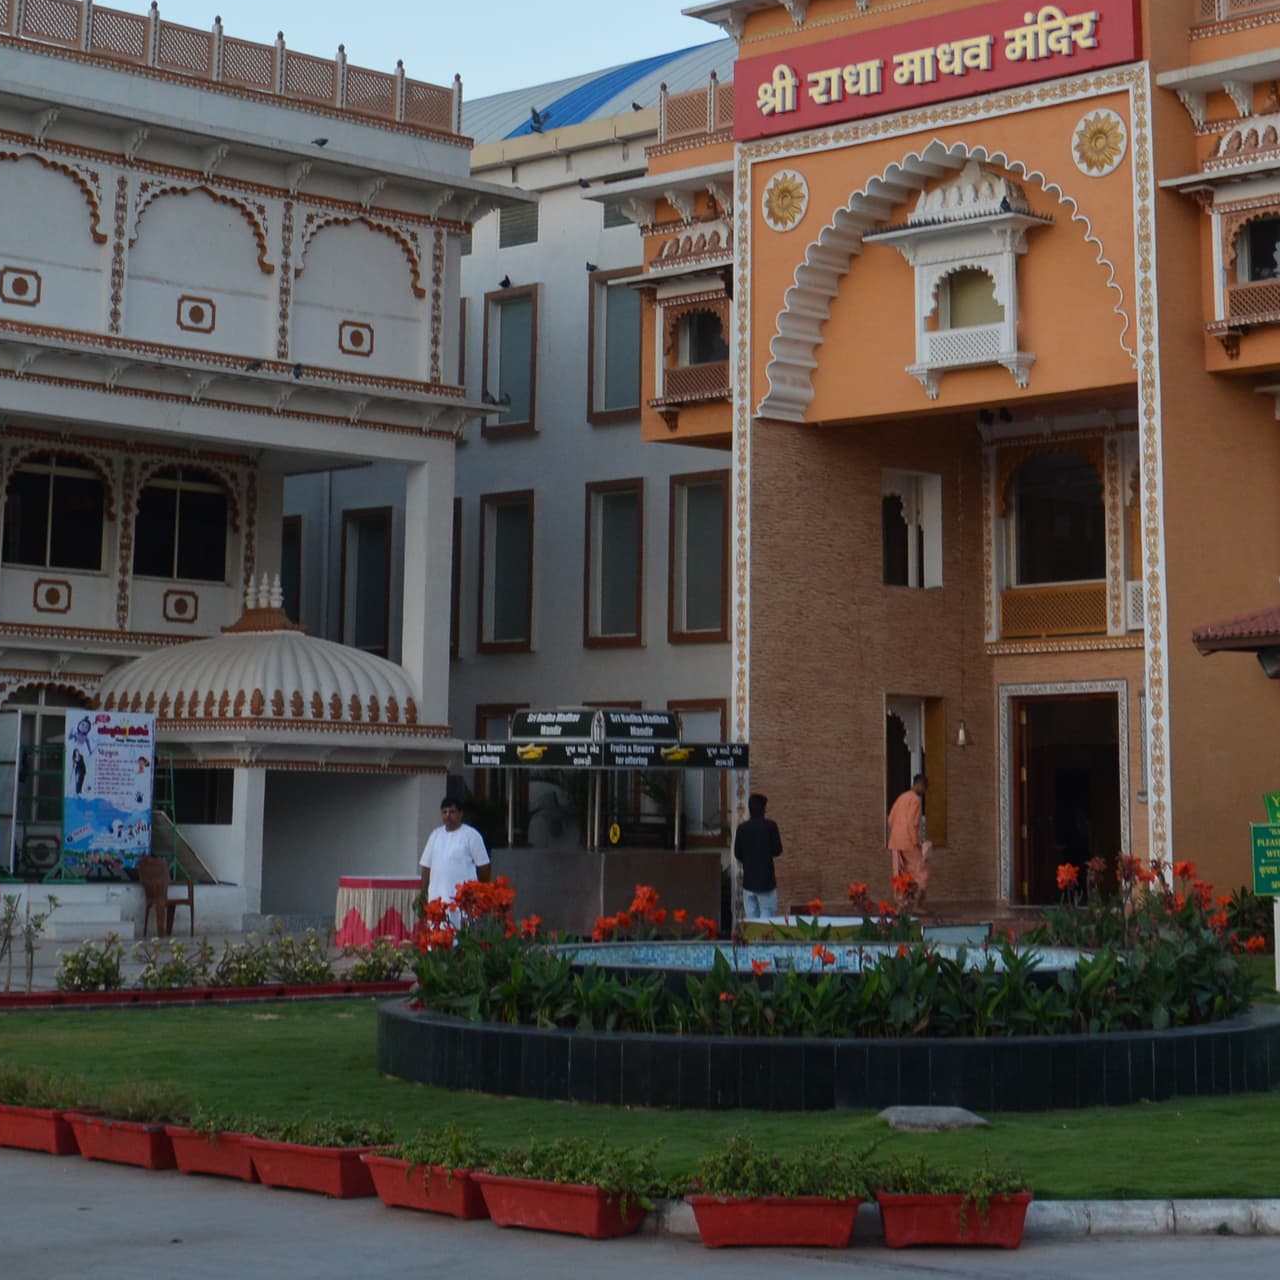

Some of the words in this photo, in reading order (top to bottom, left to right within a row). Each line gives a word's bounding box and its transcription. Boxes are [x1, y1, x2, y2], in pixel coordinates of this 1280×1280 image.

[755, 63, 798, 117] श्री
[807, 57, 884, 106] राधा
[892, 34, 993, 86] माधव
[1004, 5, 1100, 62] मंदिर
[527, 712, 537, 723] Sri
[610, 713, 620, 724] Sri
[621, 714, 642, 724] Radha
[643, 714, 669, 724] Madhav
[540, 725, 562, 736] Mandir
[630, 726, 654, 737] Mandir
[610, 743, 627, 753] Fruits
